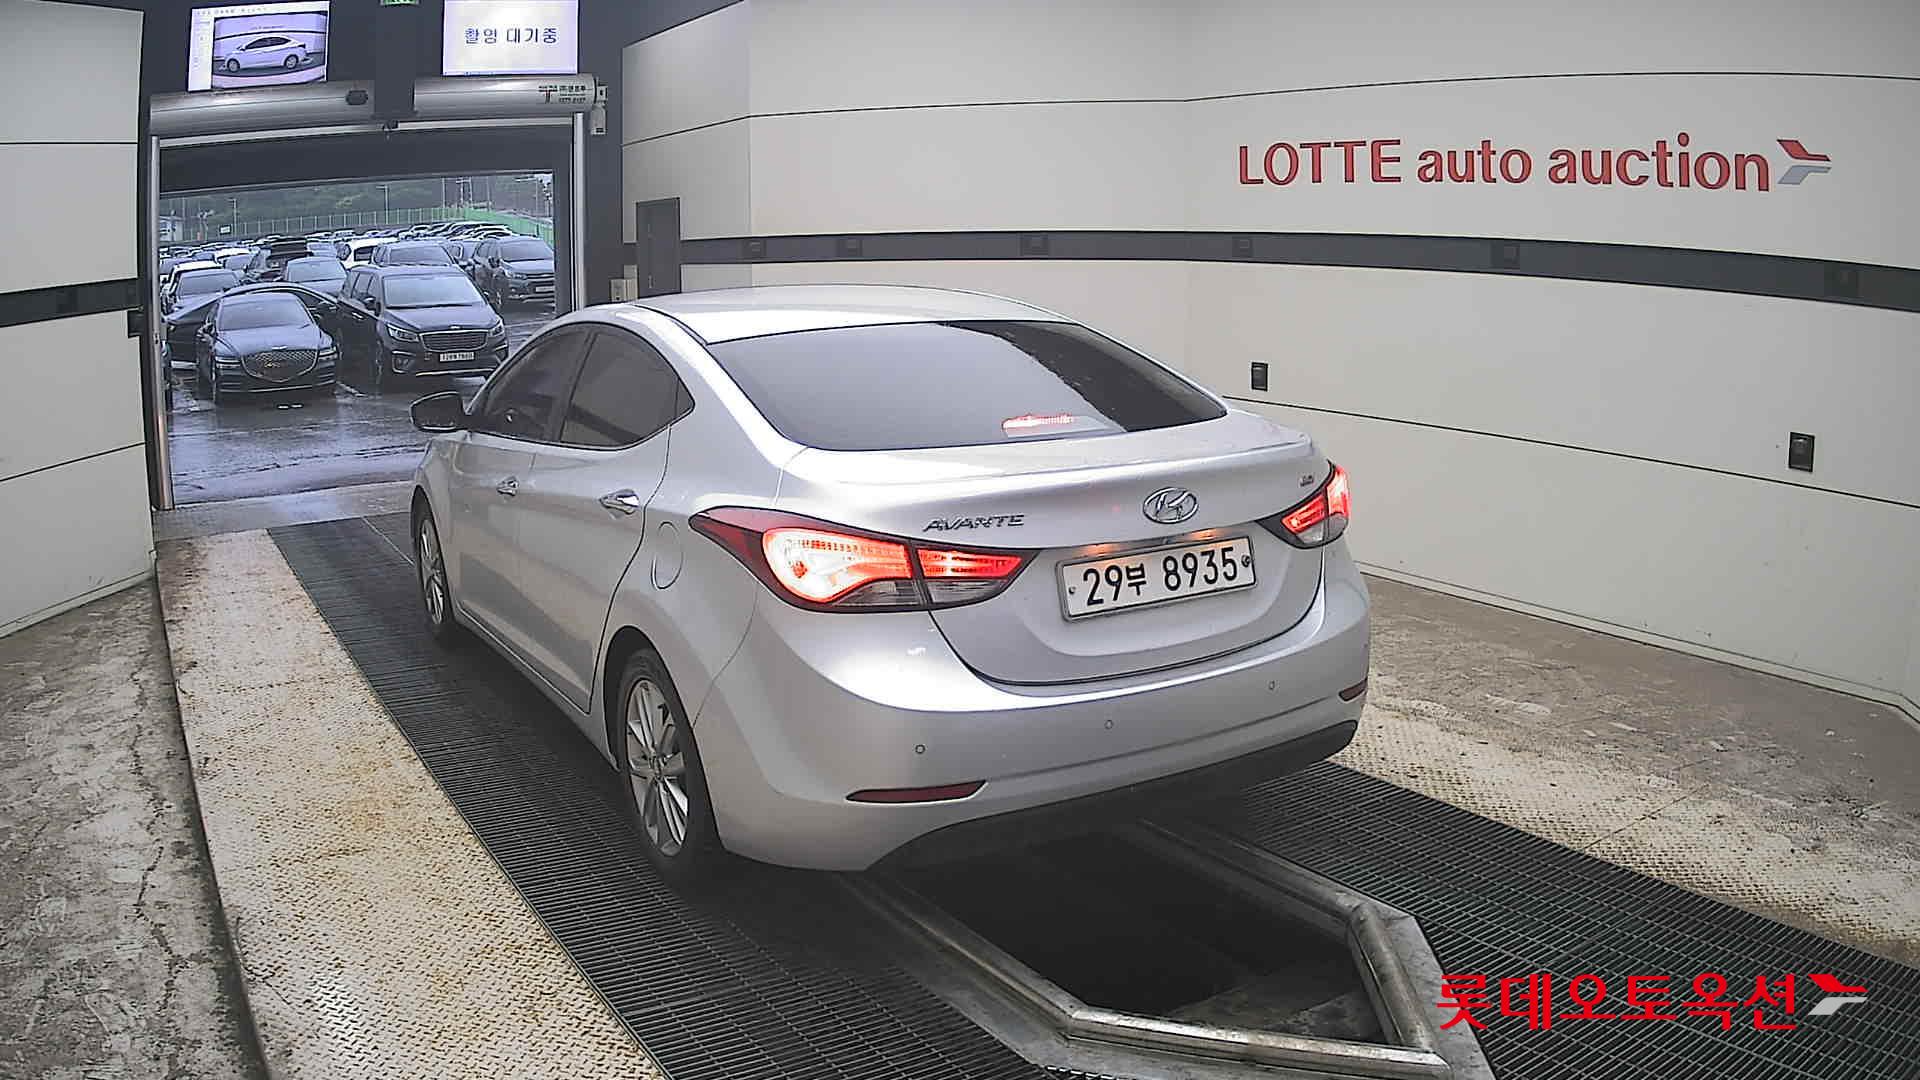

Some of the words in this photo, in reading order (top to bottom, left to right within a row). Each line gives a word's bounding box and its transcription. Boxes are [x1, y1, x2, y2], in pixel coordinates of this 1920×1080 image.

[506, 27, 557, 44] 대기중
[1239, 139, 1401, 184] LOTTE
[1417, 139, 1532, 184] auto
[1548, 132, 1769, 191] auction
[922, 514, 1025, 532] AVANTE
[1083, 562, 1147, 606] 29부
[1162, 546, 1238, 592] 8935
